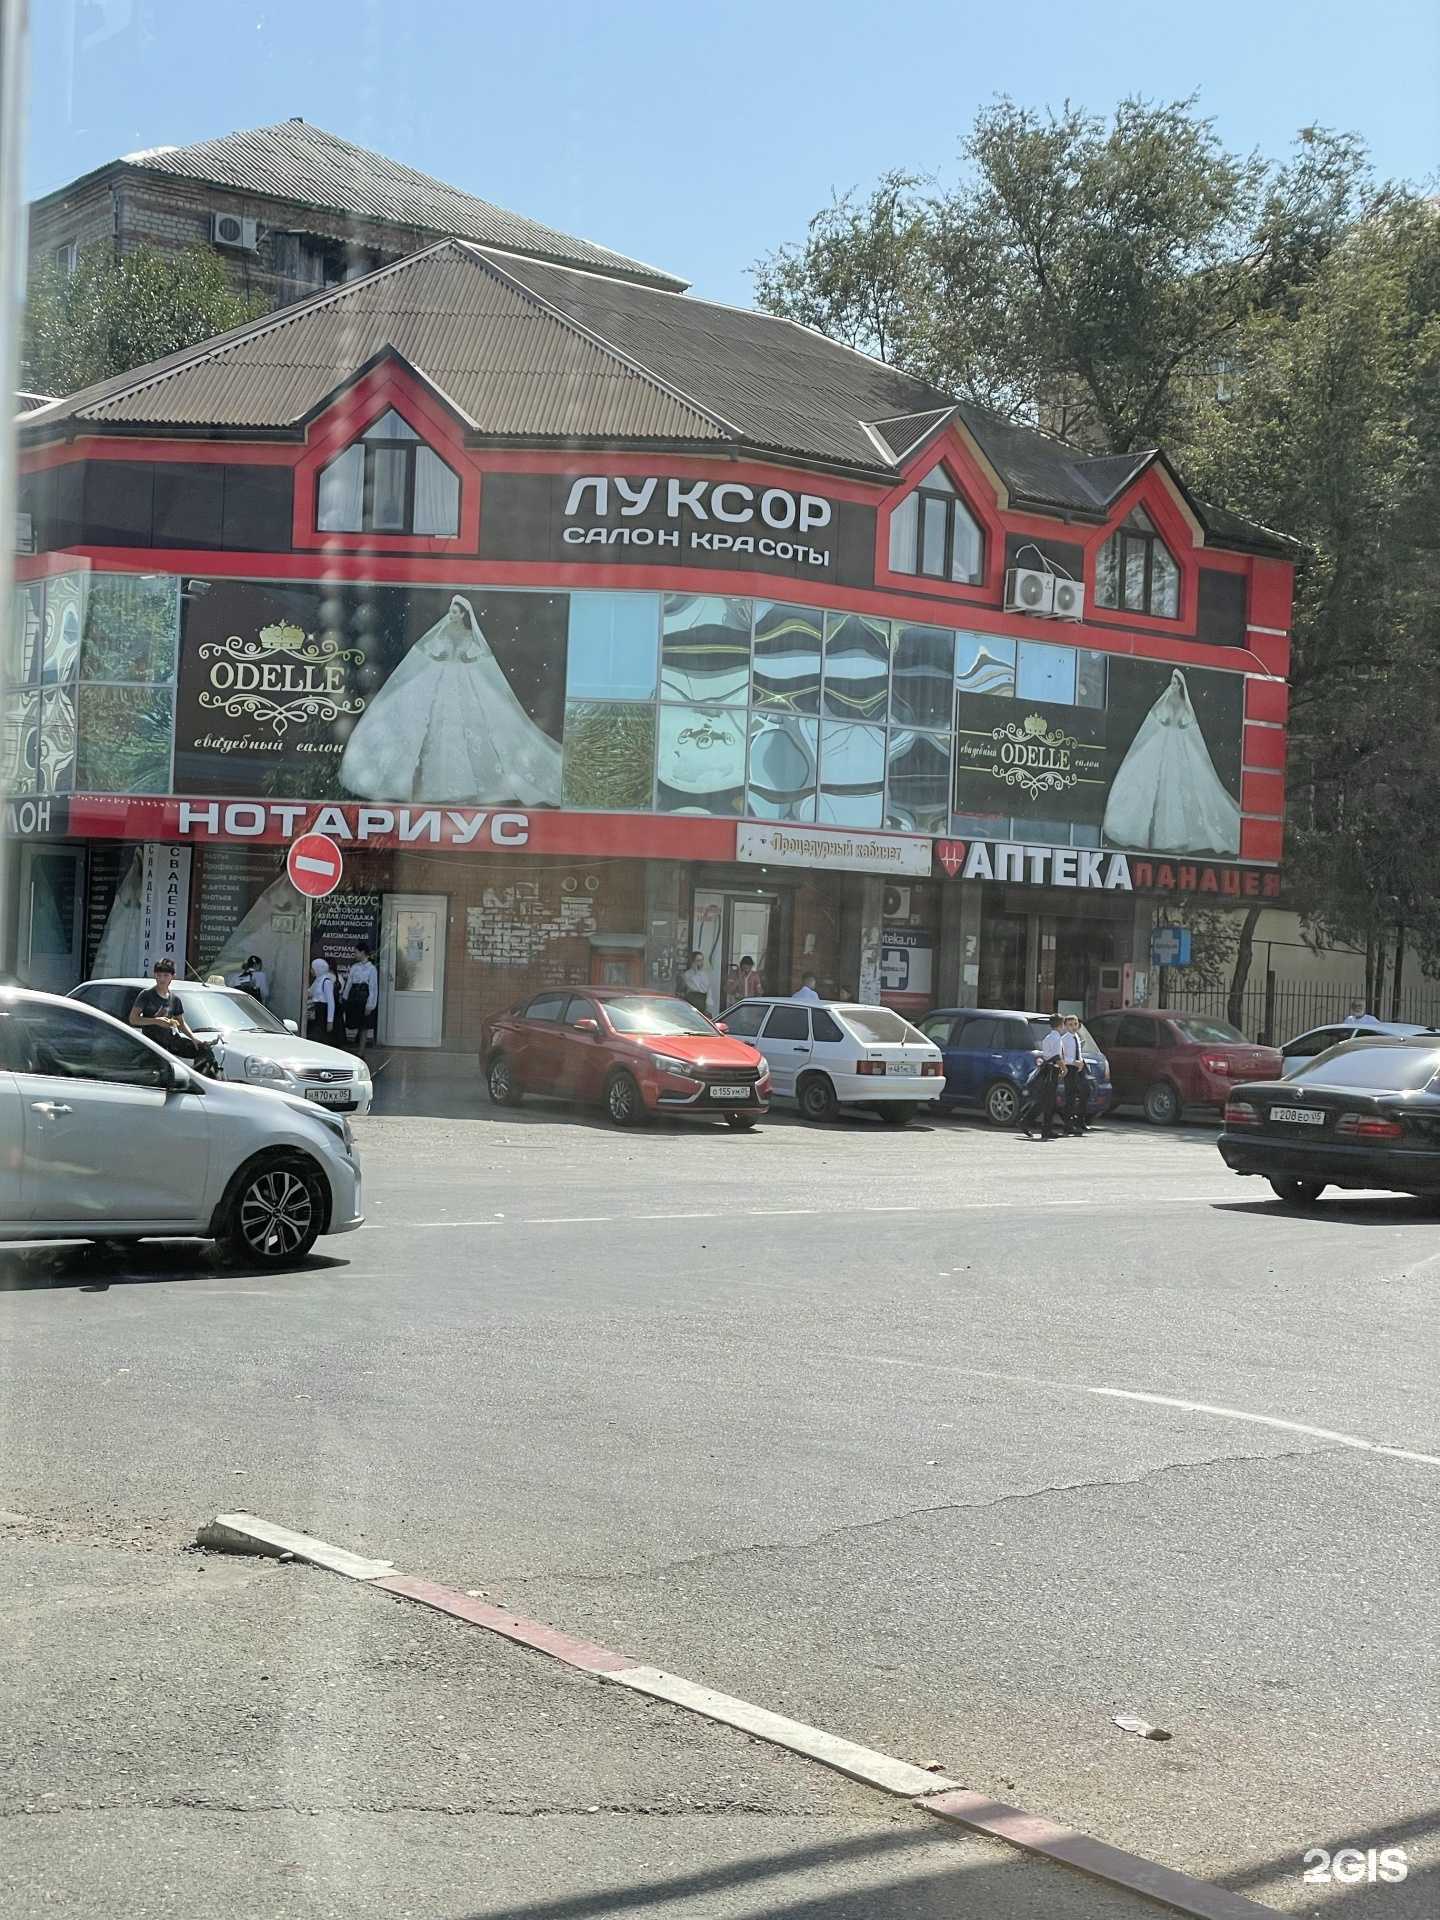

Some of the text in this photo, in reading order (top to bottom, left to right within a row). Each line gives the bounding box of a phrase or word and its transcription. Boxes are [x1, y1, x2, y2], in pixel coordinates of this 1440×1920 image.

[564, 476, 832, 533] ЛУКСОР
[562, 526, 831, 568] САЛОН КРАСОТЫ
[209, 661, 346, 695] ODELLE
[193, 733, 285, 754] свадебный
[1000, 742, 1071, 771] ODELLE
[5, 800, 51, 834] ЛОН
[178, 801, 530, 847] НОТАРИУС
[769, 831, 902, 861] Процедурный кабинет
[961, 841, 1282, 897] АПТЕКА ПАНАЦЕЯ
[165, 847, 180, 953] СВАДЕБНЫЙ
[882, 932, 917, 946] teka.ru
